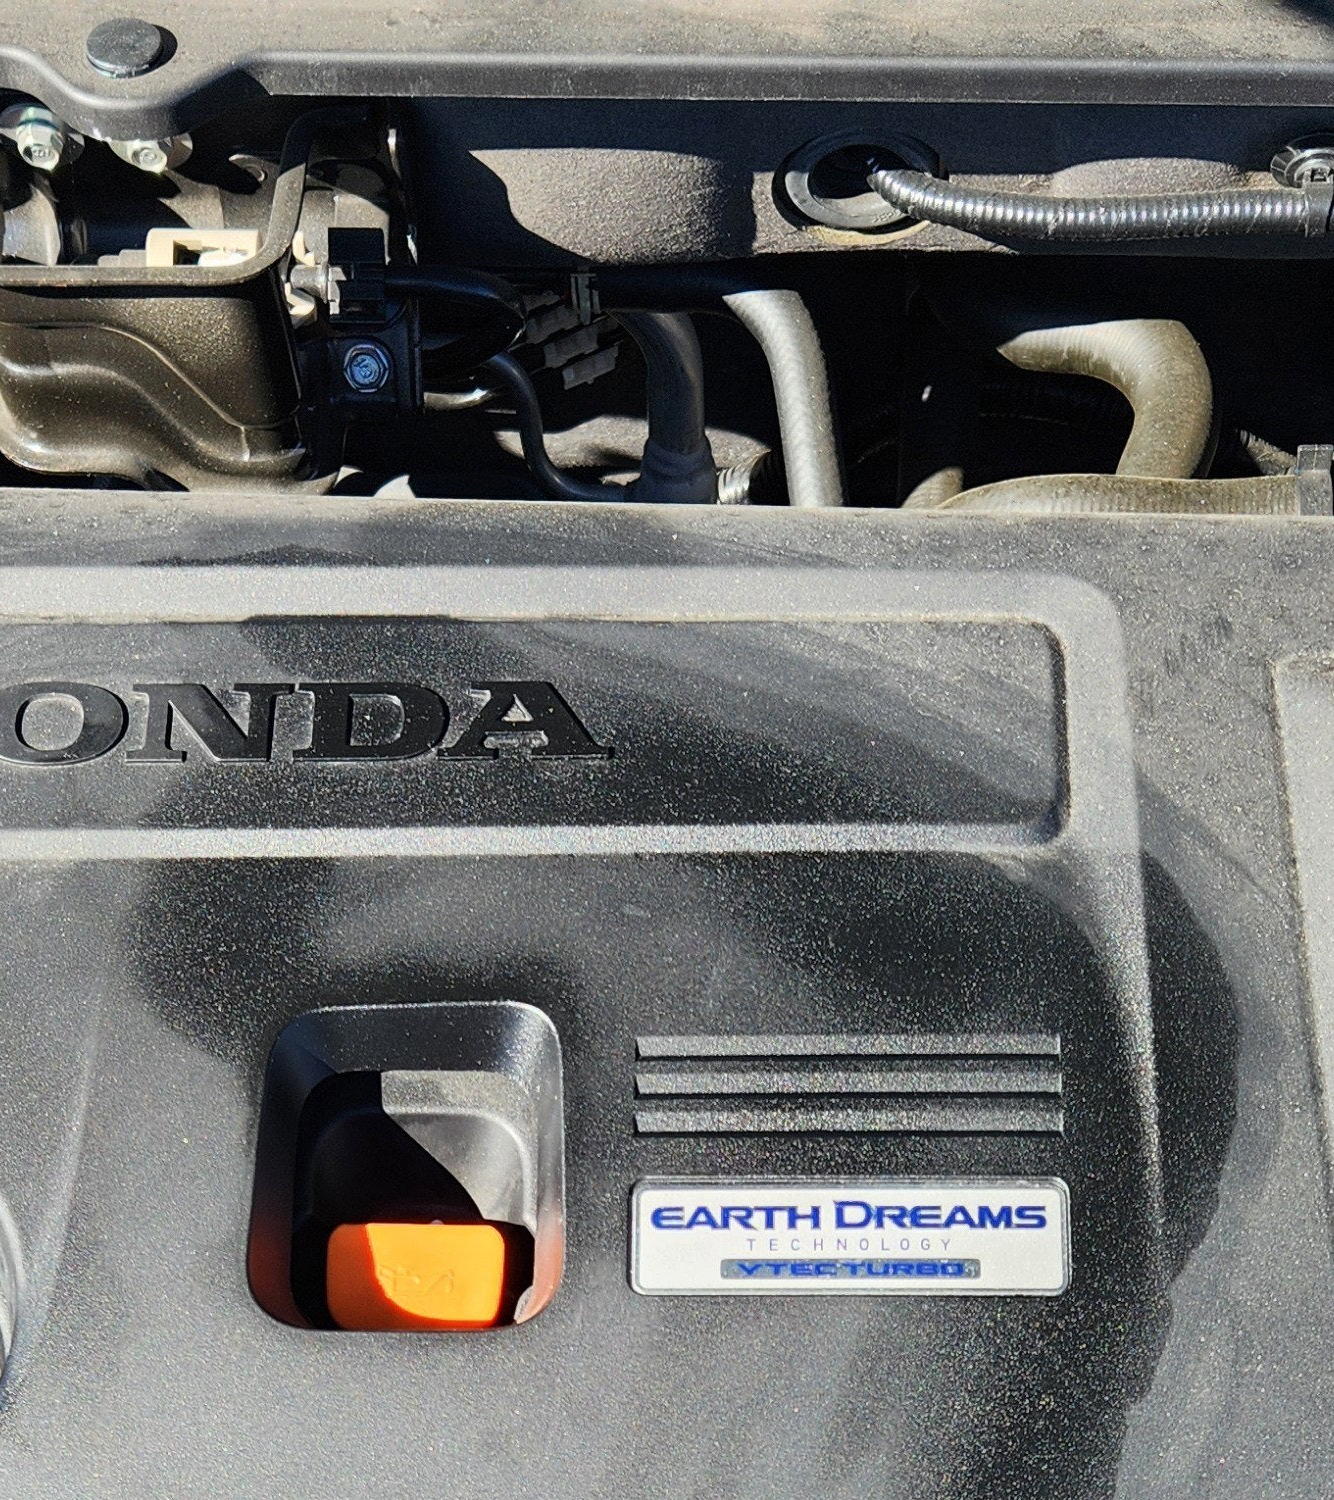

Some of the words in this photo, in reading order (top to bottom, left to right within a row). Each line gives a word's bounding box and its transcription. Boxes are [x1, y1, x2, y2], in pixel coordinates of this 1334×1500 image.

[650, 1205, 820, 1230] EARTH
[833, 1200, 1047, 1230] DREAMS
[746, 1238, 953, 1251] TECHNOLOGY
[737, 1262, 838, 1277] VTEC
[841, 1262, 966, 1277] TURBO
